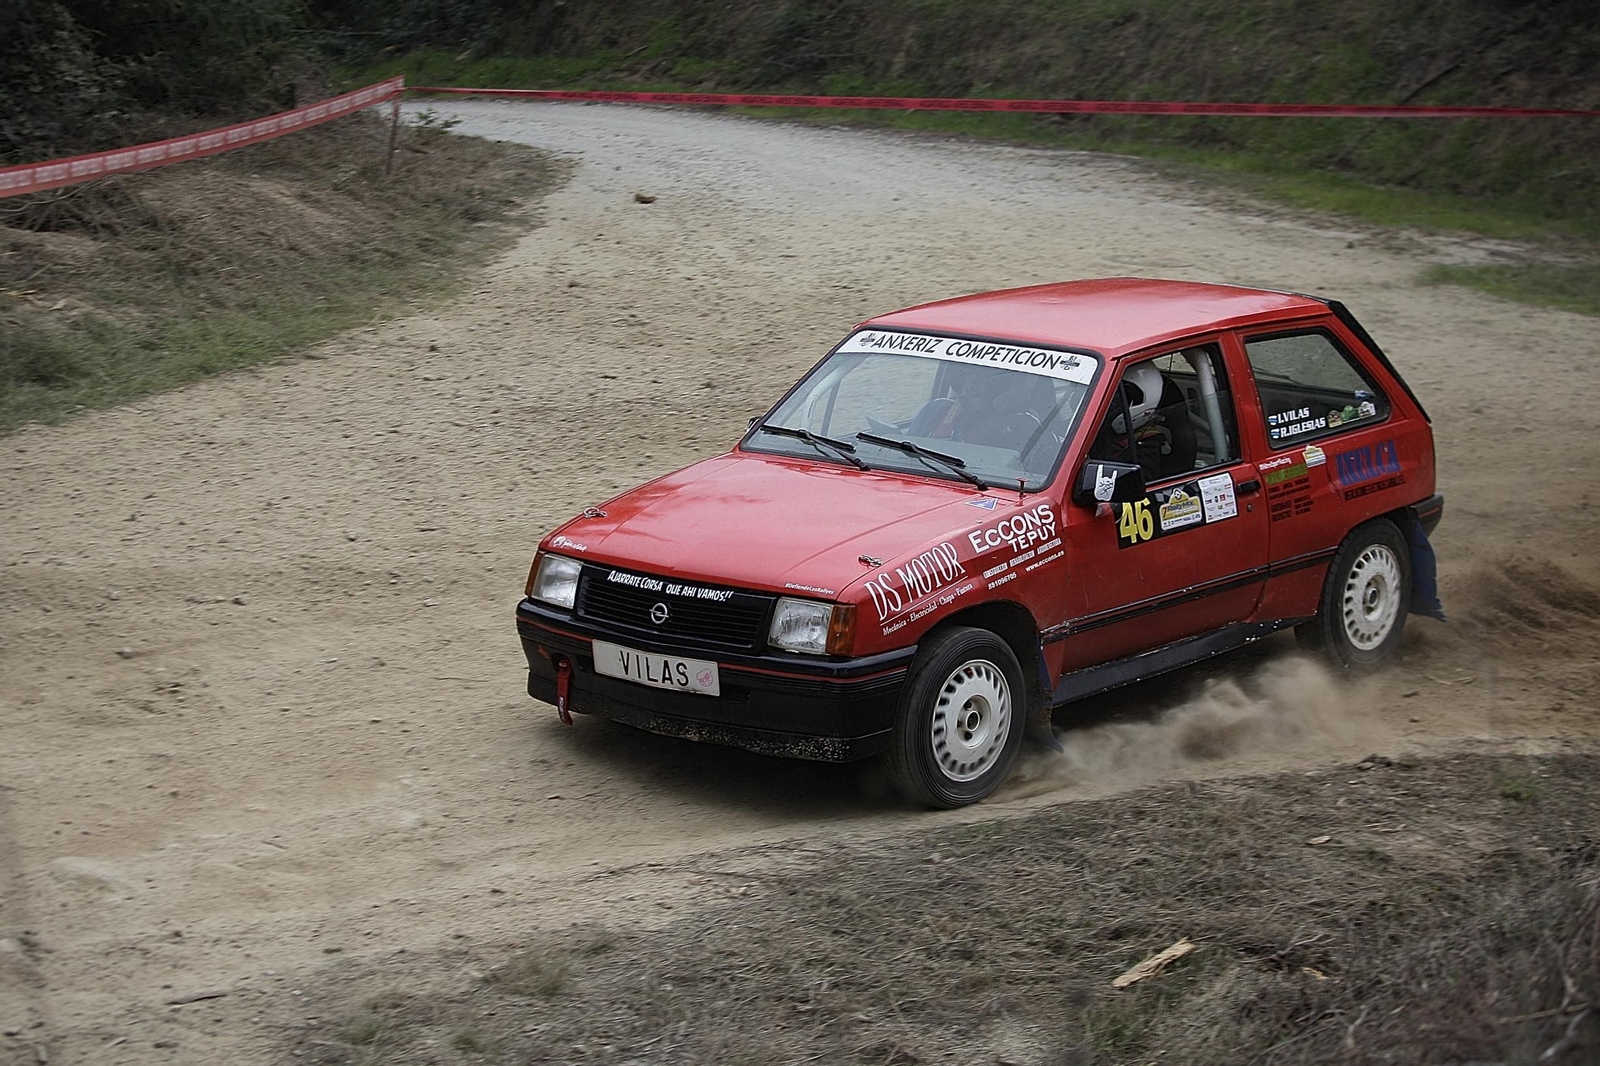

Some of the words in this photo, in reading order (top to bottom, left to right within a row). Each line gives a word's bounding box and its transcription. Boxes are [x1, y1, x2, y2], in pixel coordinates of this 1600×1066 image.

[871, 334, 943, 353] ANXERIZ
[945, 341, 1062, 370] COMPETICION
[1280, 417, 1326, 438] R.IGLESIAS
[1007, 522, 1057, 552] TEPUY
[1119, 497, 1154, 544] 46
[1025, 550, 1065, 572] www.eccons.es
[607, 570, 642, 587] AJARRATE
[665, 584, 682, 595] QUE
[681, 586, 698, 597] AHI
[697, 588, 734, 601] VAMOS!!
[864, 572, 902, 621] DS
[896, 542, 966, 603] MOTOR
[909, 601, 938, 622] Electricidad
[939, 595, 955, 606] Chapa
[955, 583, 973, 596] Pintura
[619, 650, 690, 687] VILAS
